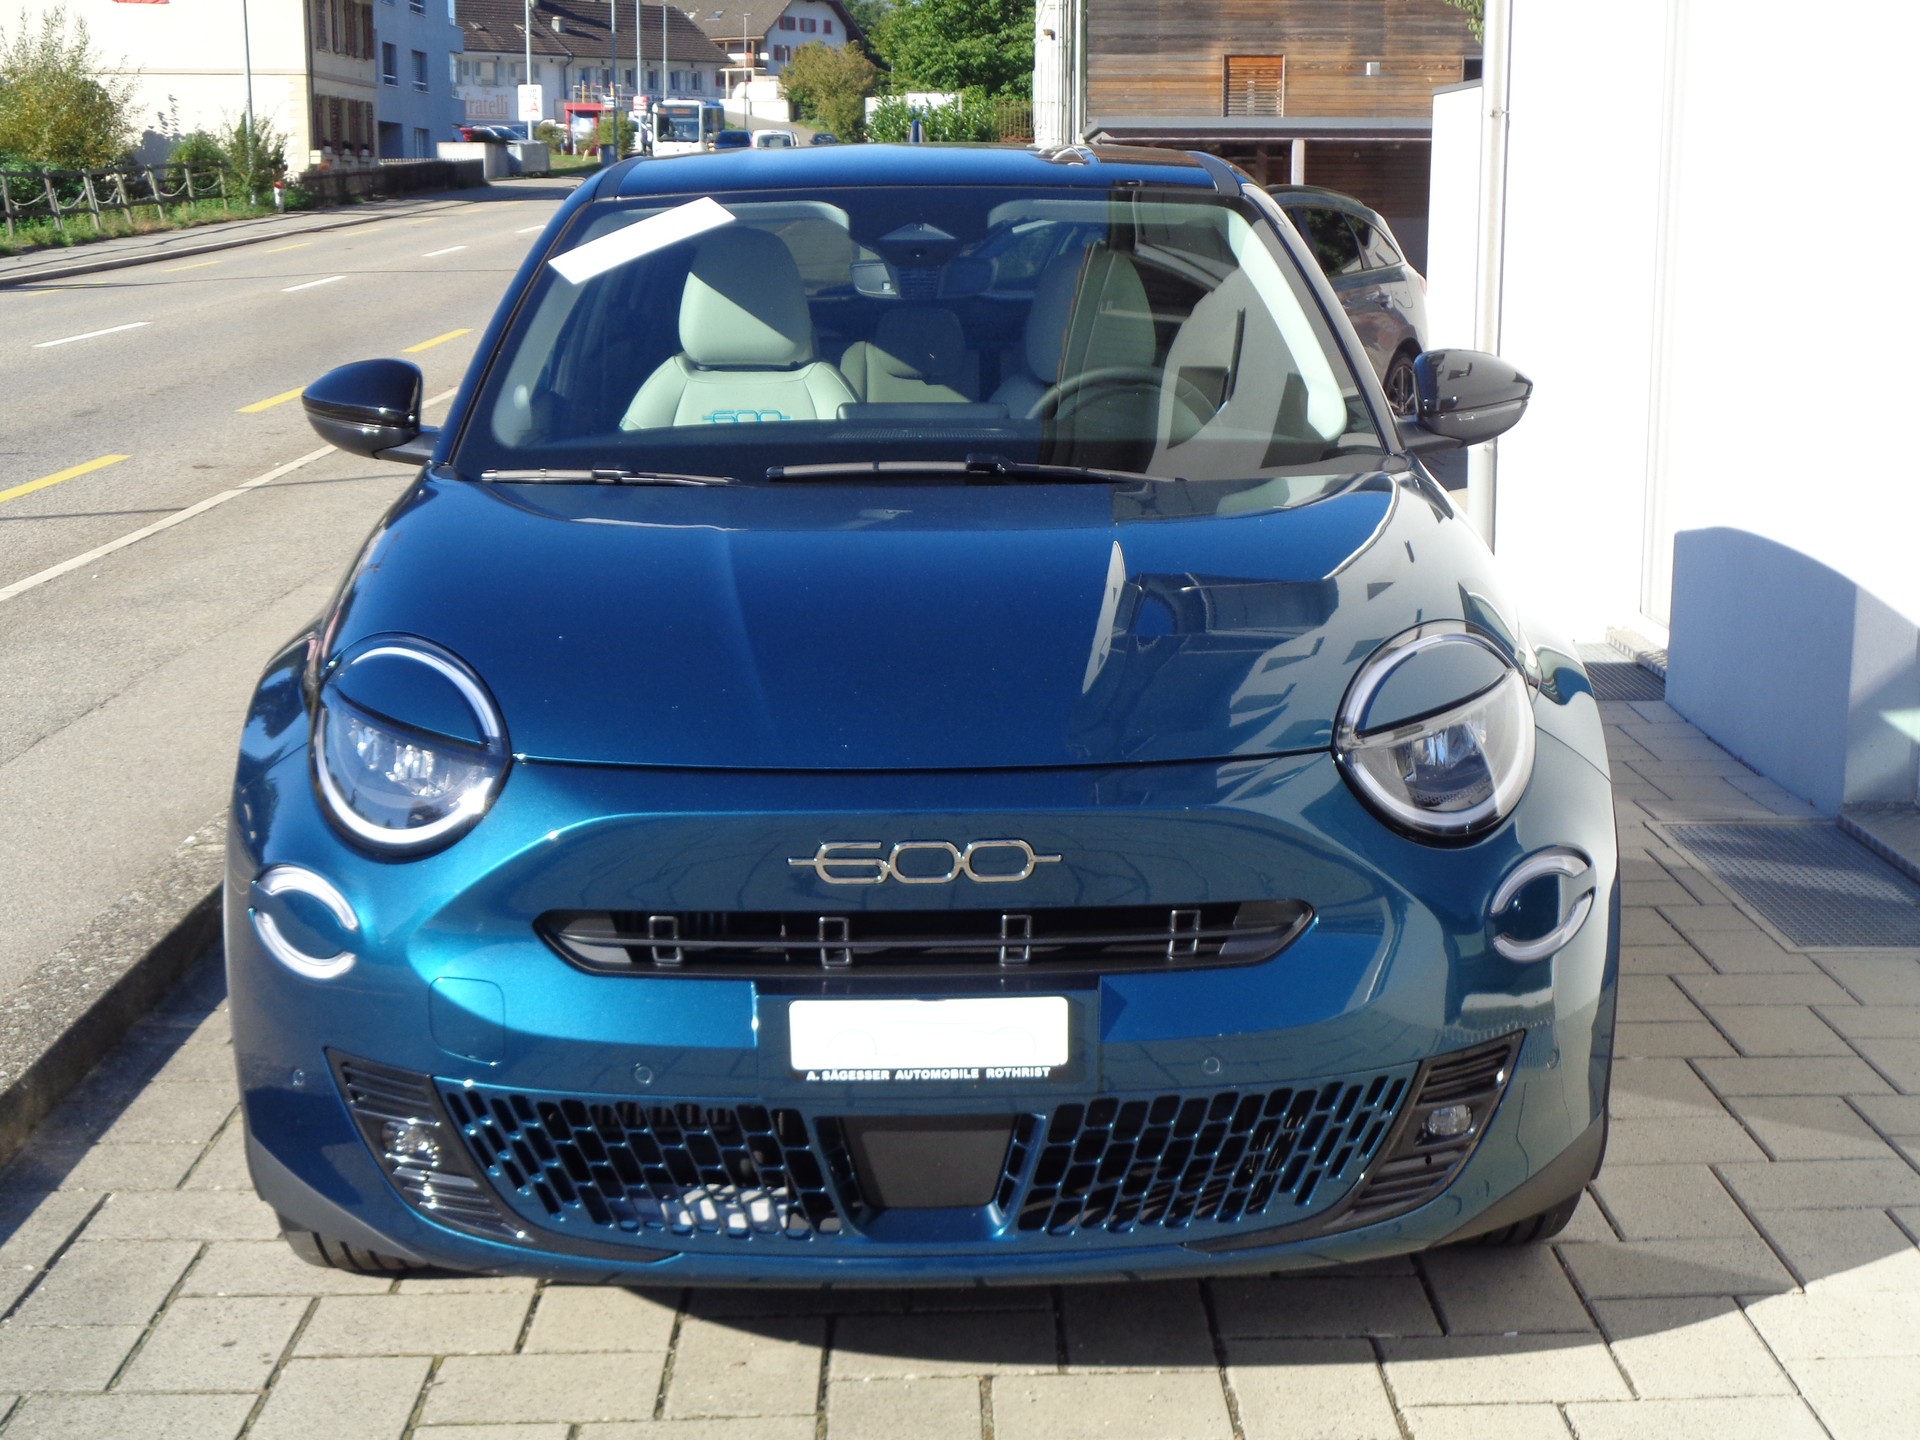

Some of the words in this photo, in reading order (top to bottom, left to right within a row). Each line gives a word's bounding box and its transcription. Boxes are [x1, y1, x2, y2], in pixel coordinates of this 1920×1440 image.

[464, 92, 509, 115] fratelli
[813, 839, 1036, 885] 600
[806, 1070, 820, 1081] A.
[895, 1068, 979, 1080] AUTOMOBILE
[985, 1066, 1051, 1079] ROTHRIST
